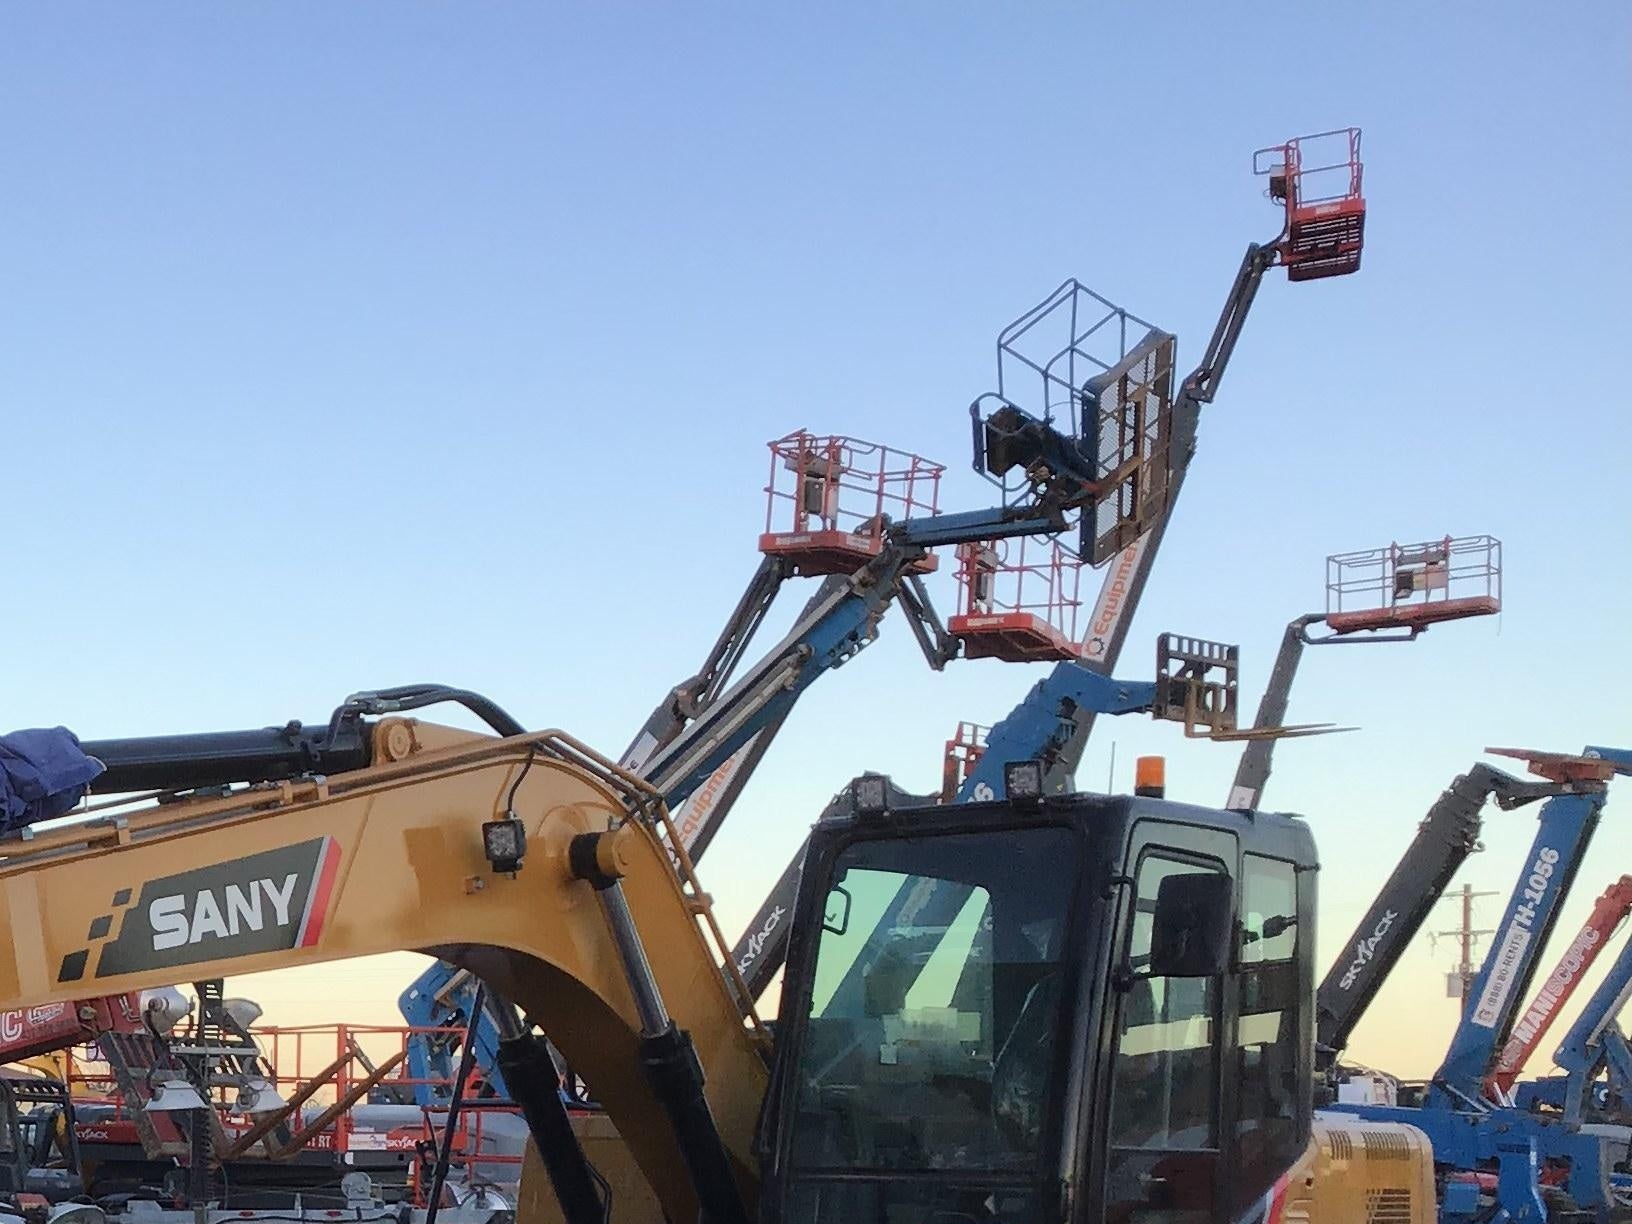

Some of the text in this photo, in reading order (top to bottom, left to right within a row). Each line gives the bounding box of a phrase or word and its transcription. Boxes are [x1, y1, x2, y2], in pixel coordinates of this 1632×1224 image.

[150, 873, 298, 951] SANY
[1339, 909, 1399, 990] SKYJACK
[1515, 925, 1600, 1044] MANISCOPIC
